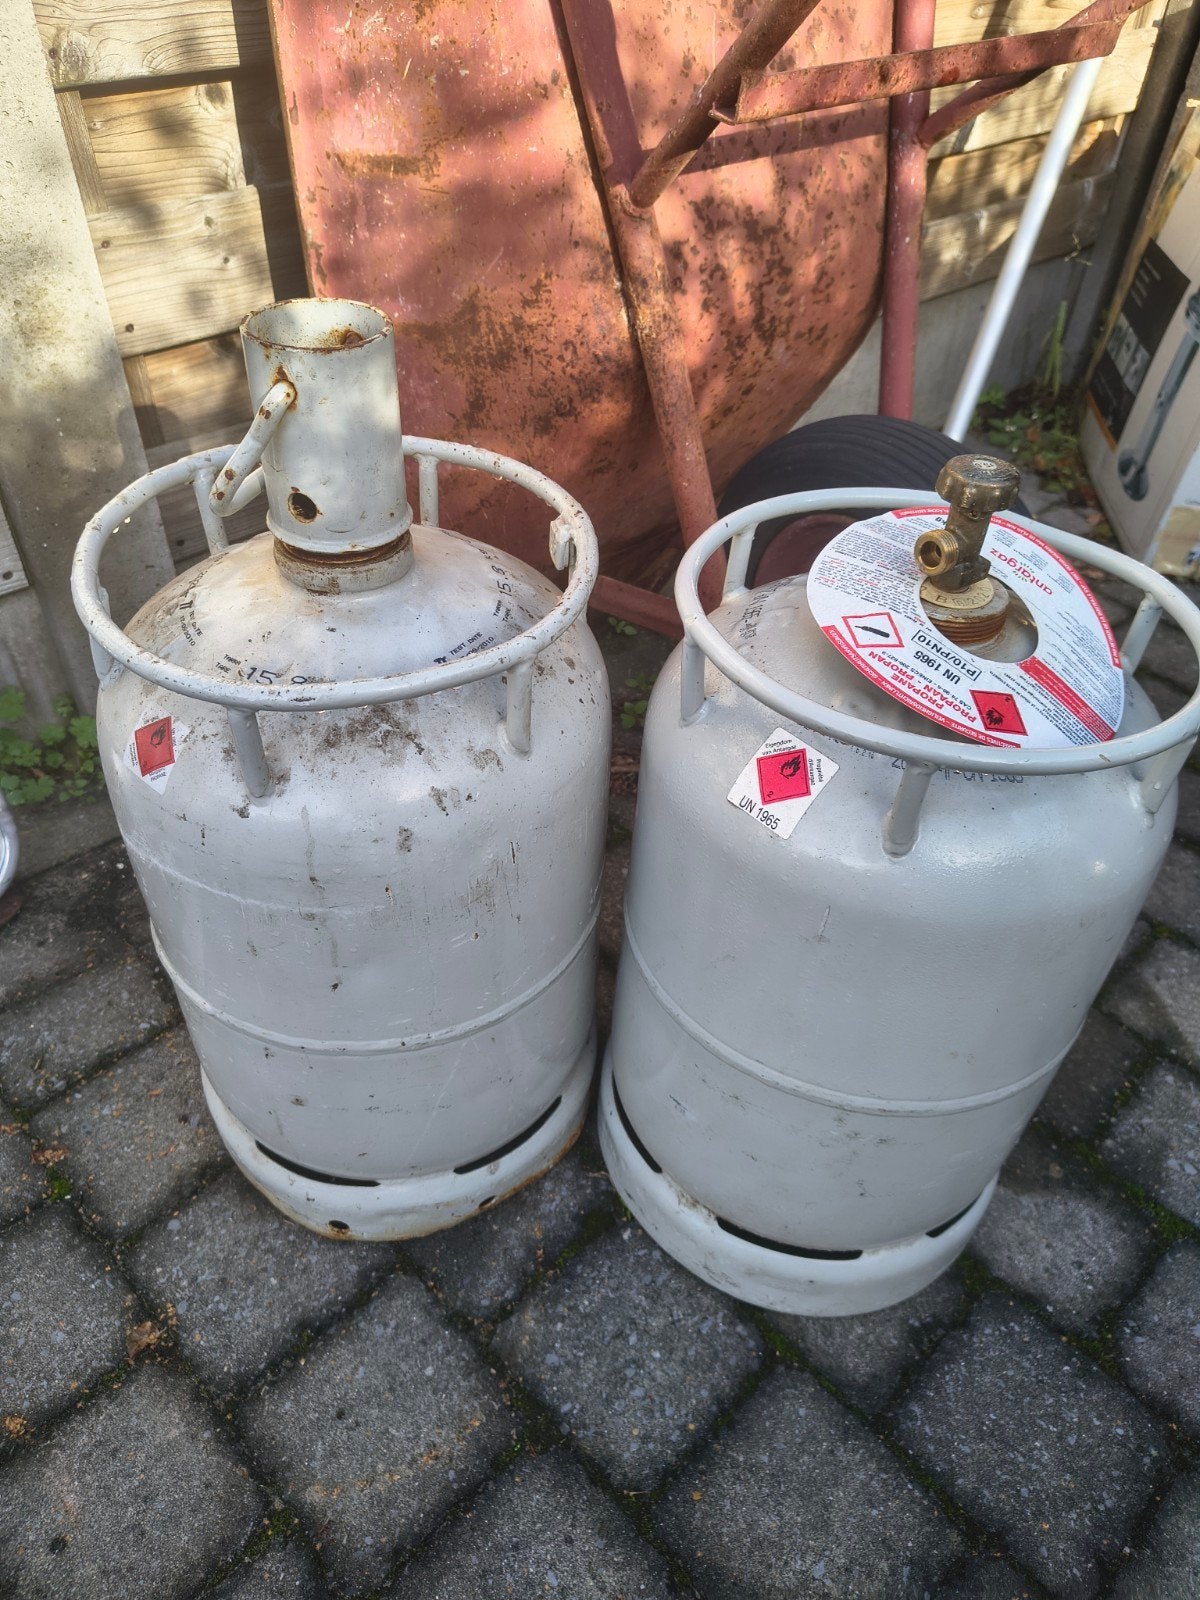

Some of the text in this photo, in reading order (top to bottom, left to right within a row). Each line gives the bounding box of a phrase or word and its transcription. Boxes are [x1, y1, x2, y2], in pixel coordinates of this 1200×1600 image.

[990, 547, 1053, 595] antargaz
[868, 650, 915, 681] PROPAN
[913, 650, 962, 685] UN 1965
[917, 634, 977, 677] P10/PN10
[890, 672, 945, 710] PROPANE
[923, 684, 977, 723] PROPAAN
[739, 795, 780, 830] UN 1965
